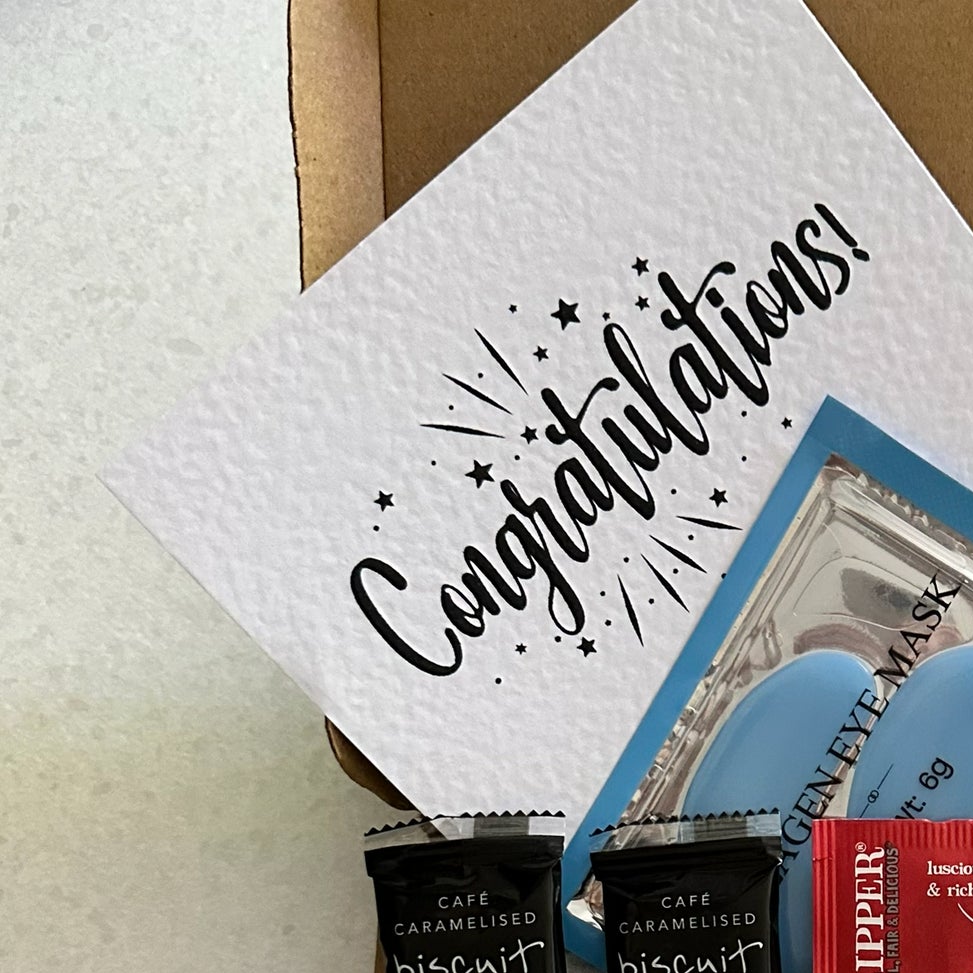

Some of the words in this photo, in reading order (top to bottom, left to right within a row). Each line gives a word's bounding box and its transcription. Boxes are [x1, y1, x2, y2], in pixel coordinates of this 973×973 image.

[350, 203, 869, 677] Congratulations!
[825, 689, 890, 769] EYE
[874, 574, 962, 689] MASK
[918, 757, 954, 791] 6g
[438, 890, 489, 910] CAFÉ
[661, 891, 711, 910] CAFÉ
[927, 883, 941, 897] &
[394, 911, 537, 936] CARAMELISED
[618, 912, 757, 934] CARAMELISED
[887, 917, 898, 928] &
[887, 928, 898, 958] FAIR
